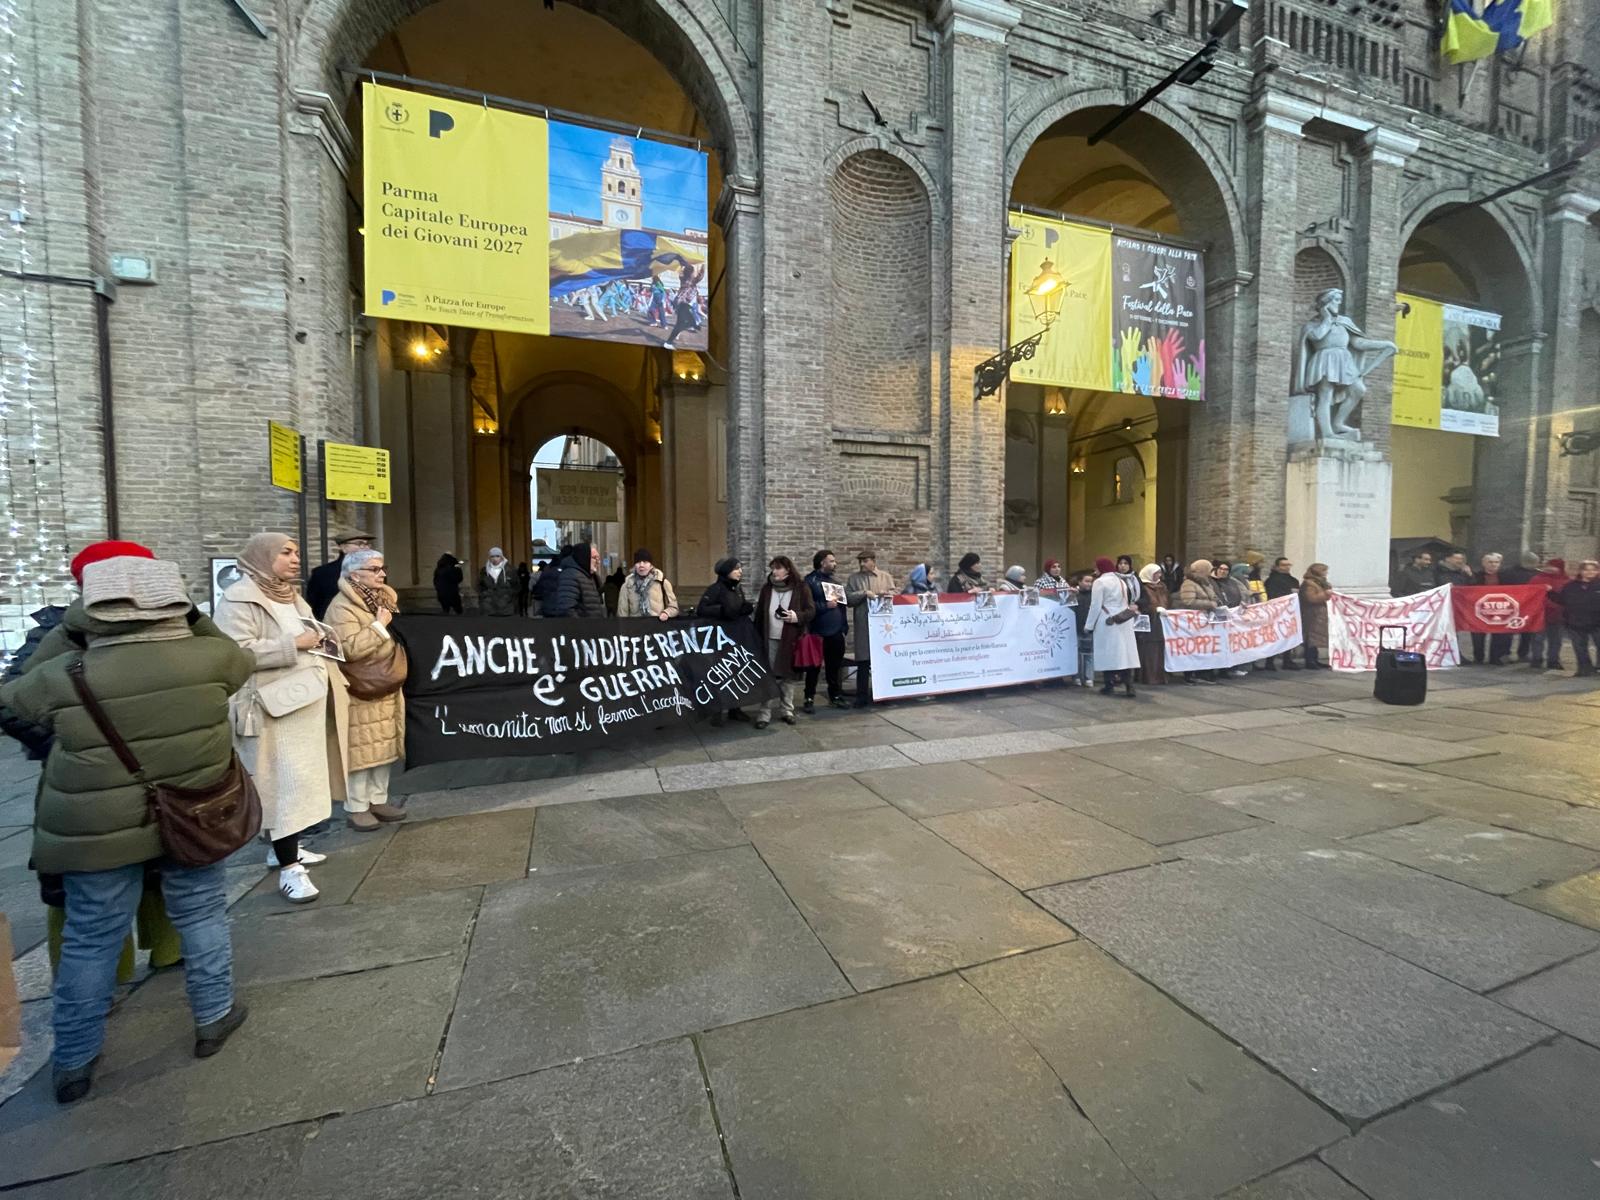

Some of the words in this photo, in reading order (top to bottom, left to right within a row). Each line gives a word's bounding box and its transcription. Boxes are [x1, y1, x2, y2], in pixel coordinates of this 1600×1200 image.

[382, 181, 438, 203] Parma
[382, 202, 453, 225] Capitale
[459, 213, 528, 236] Europea
[382, 224, 408, 239] dei
[414, 227, 478, 249] Giovani
[483, 237, 523, 255] 2027
[424, 295, 430, 303] A
[433, 295, 460, 306] Piazza
[462, 298, 474, 308] for
[476, 301, 506, 312] Europe
[477, 311, 484, 319] of
[1122, 295, 1153, 313] Festival
[1154, 300, 1175, 315] della
[1176, 304, 1194, 318] Pace
[1483, 601, 1511, 609] STOP
[431, 635, 540, 680] ANCHE
[552, 625, 736, 672] L'INDIFFERENZA
[909, 650, 918, 659] per
[1166, 635, 1221, 657] TROPPE
[545, 715, 572, 735] non
[575, 706, 592, 732] si
[707, 645, 755, 685] CHIAMA
[580, 661, 682, 703] GUERRA
[720, 659, 767, 700] TUTTI
